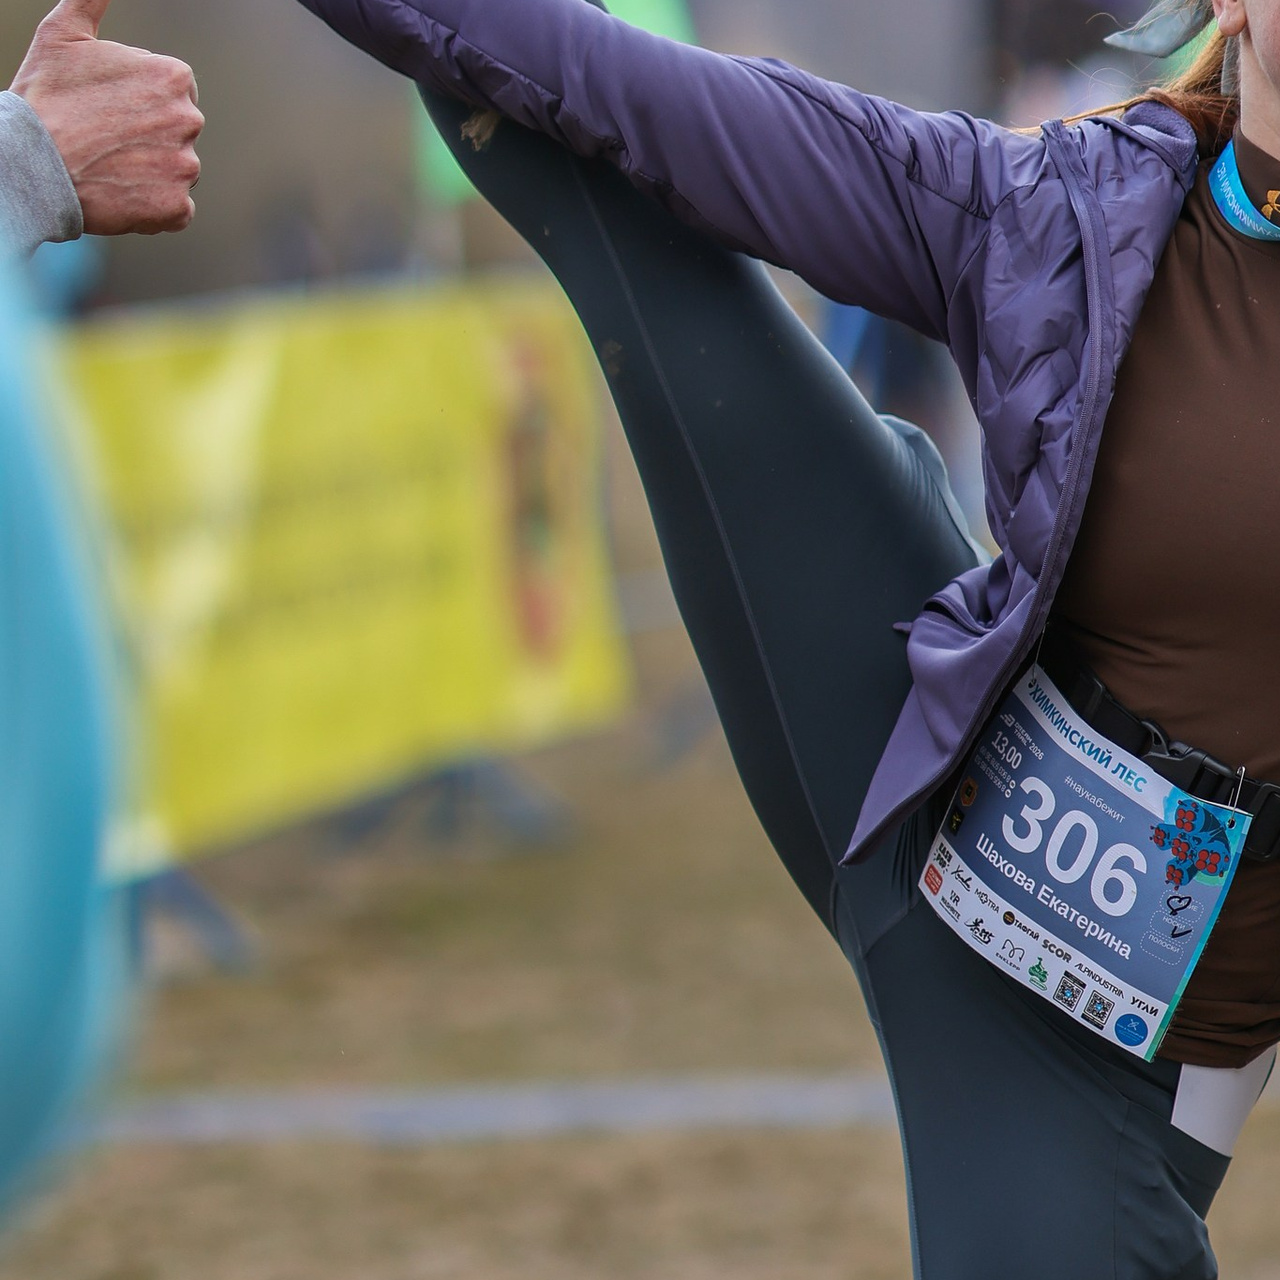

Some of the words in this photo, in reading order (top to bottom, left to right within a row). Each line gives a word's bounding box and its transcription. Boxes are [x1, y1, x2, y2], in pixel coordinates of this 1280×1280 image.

[991, 731, 1022, 769] 13,00
[1013, 728, 1028, 746] TRAIL
[1029, 743, 1044, 760] 2026
[1014, 722, 1033, 743] DREAM
[1029, 683, 1112, 770] ХИМКИНСКИЙ
[1112, 763, 1148, 793] ЛЕС
[1064, 775, 1126, 824] #наукабежит
[1002, 776, 1147, 917] 306
[976, 833, 1036, 894] Шахова
[1037, 884, 1132, 960] Екатерина
[1014, 920, 1040, 941] ТАФГАЙ
[1042, 939, 1072, 963] SCOR
[1075, 963, 1124, 999] ALPINDUSTRIA
[1131, 996, 1159, 1017] УГЛИ
